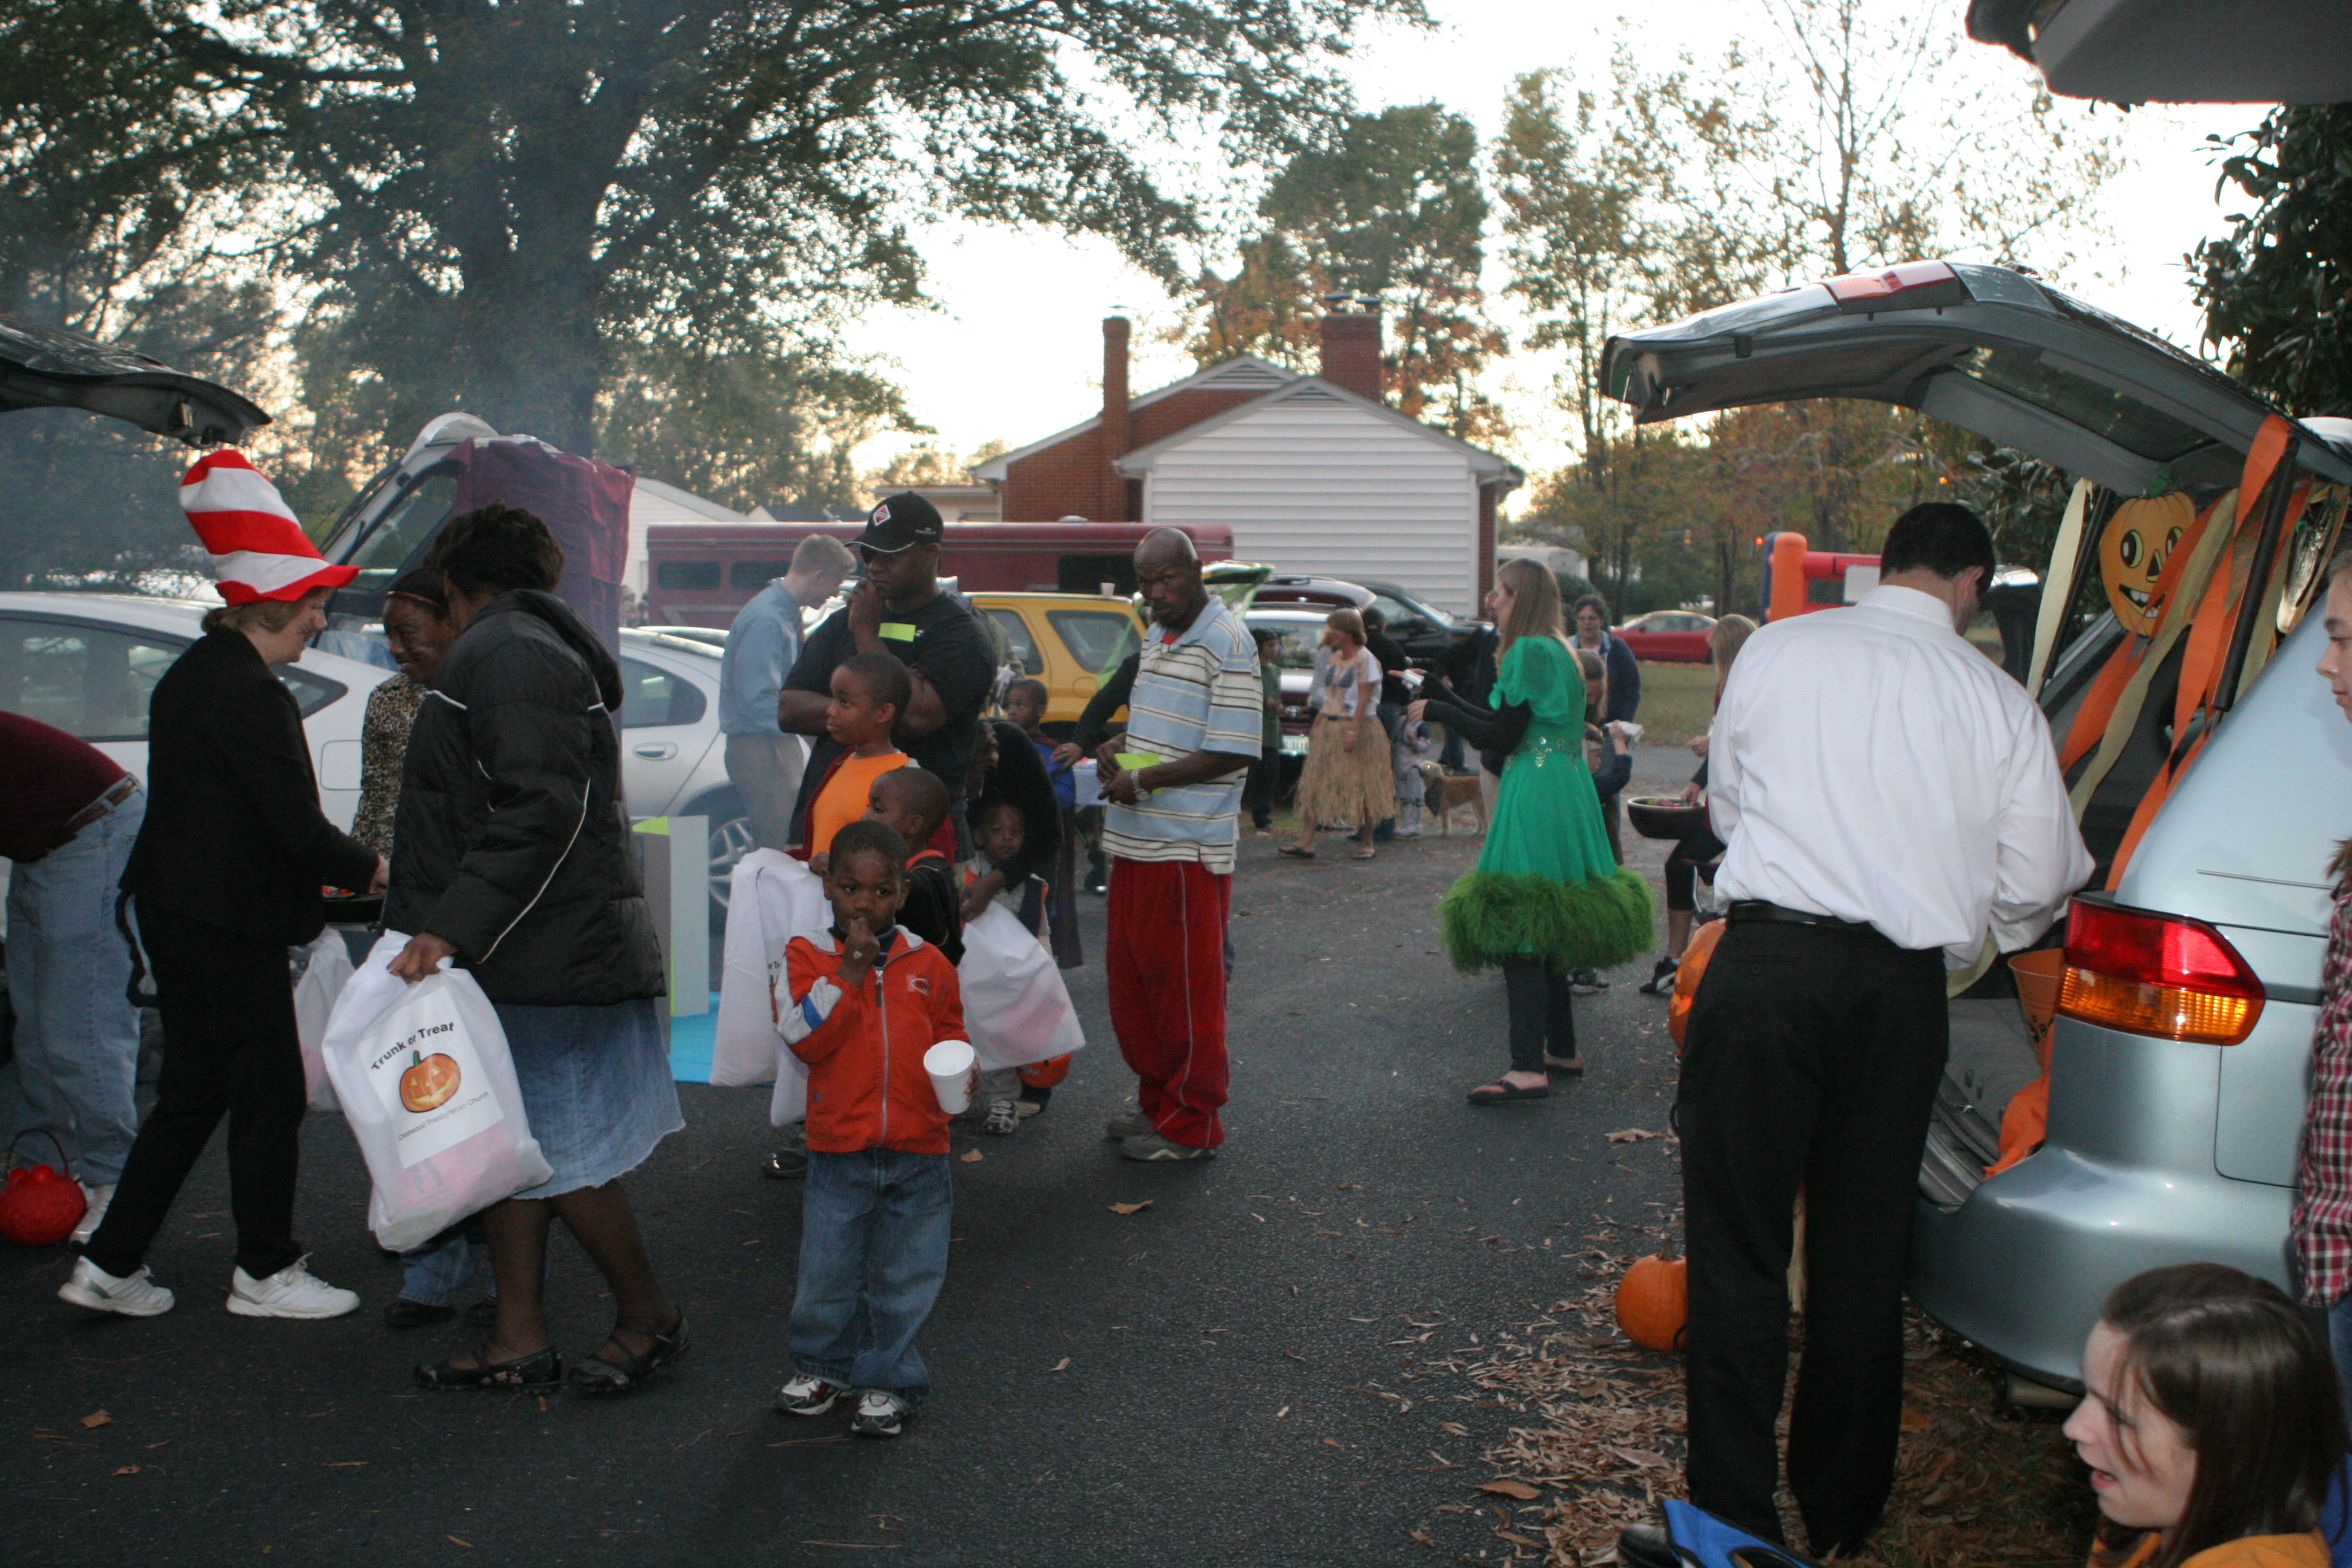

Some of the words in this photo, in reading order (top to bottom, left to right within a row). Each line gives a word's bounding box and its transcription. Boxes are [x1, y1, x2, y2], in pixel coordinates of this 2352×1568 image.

[371, 1042, 406, 1069] Trunk
[408, 1035, 417, 1045] or
[418, 1022, 454, 1038] Treat
[427, 1104, 467, 1125] Presbyterian
[468, 1091, 489, 1106] Church
